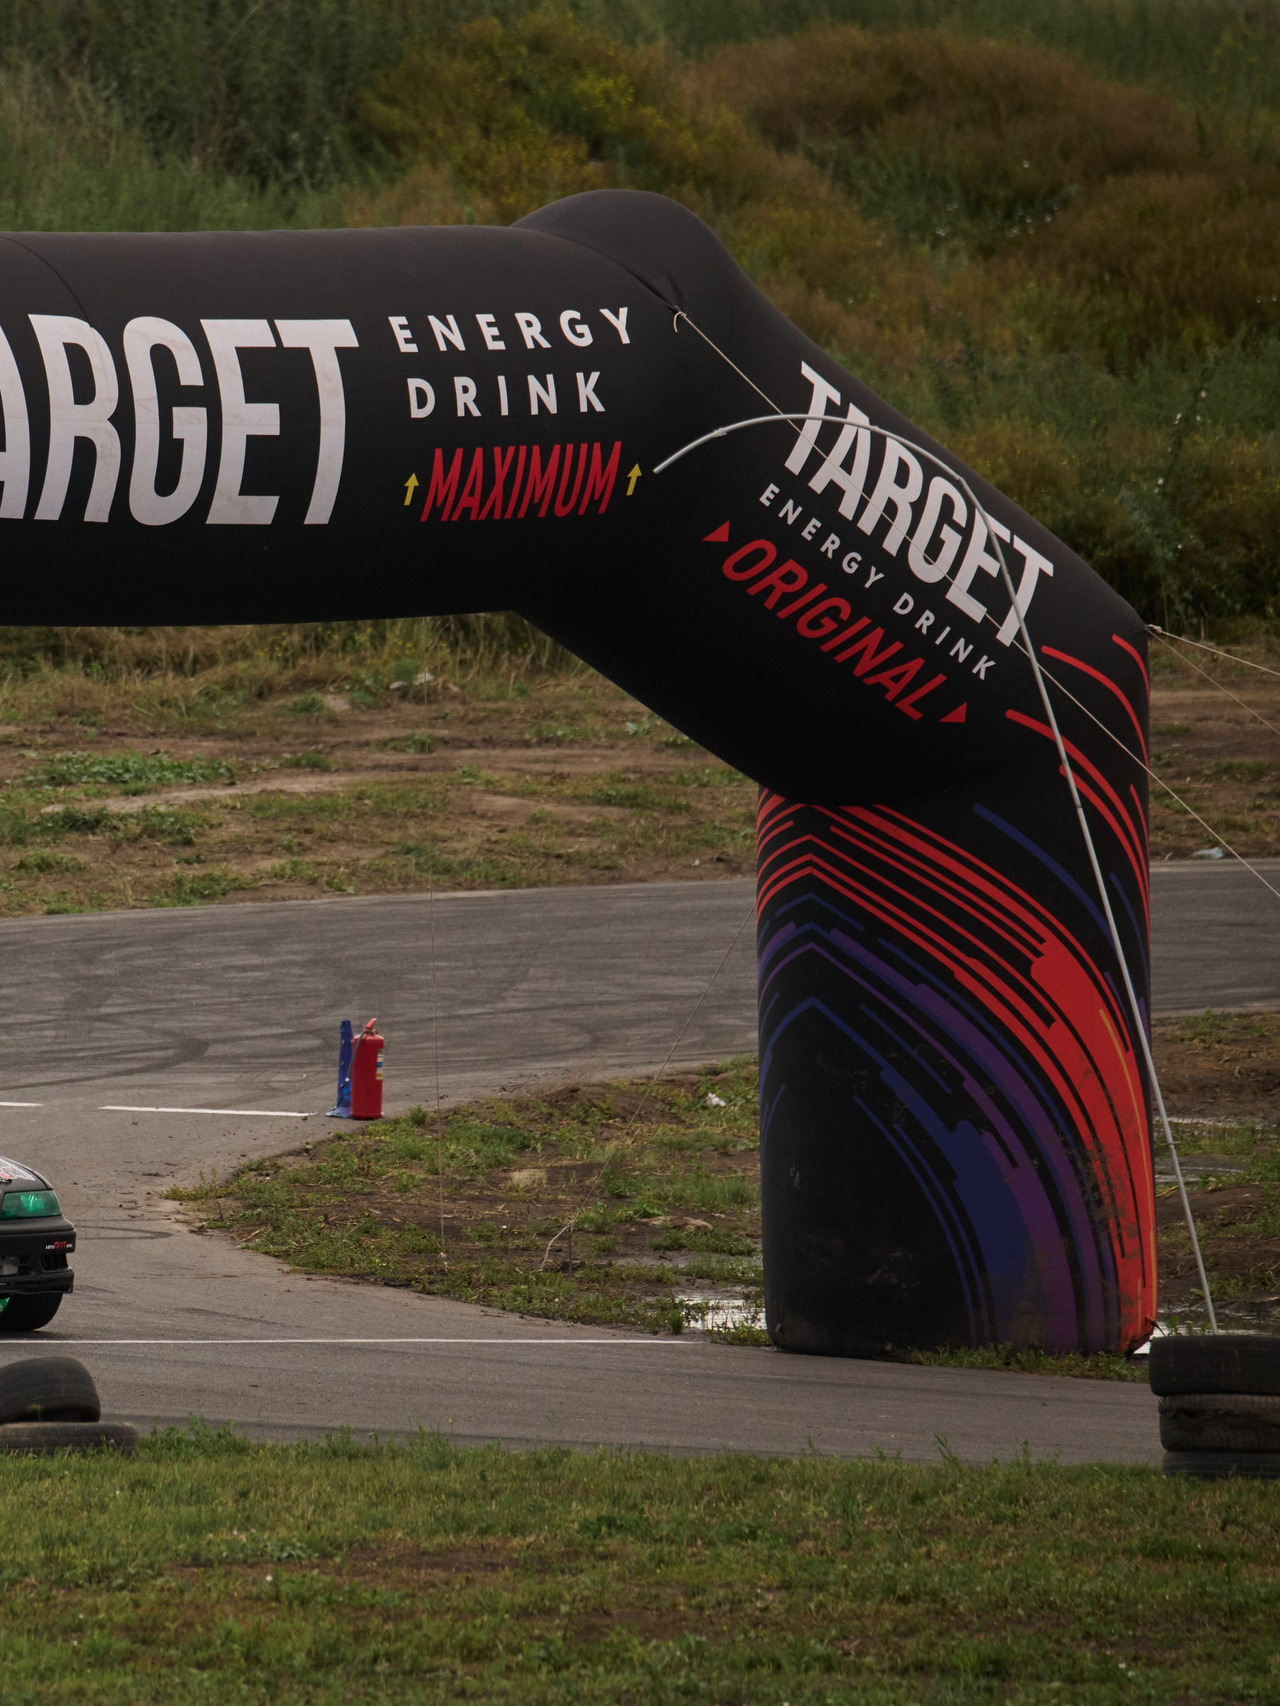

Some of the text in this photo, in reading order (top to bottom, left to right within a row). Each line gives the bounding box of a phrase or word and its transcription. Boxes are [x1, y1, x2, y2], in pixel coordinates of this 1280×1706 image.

[388, 307, 631, 353] ENERGY
[407, 371, 606, 419] DRINK
[419, 440, 622, 522] MAXIMUM
[784, 360, 1054, 647] TARGET
[722, 539, 947, 721] ORIGINAL
[759, 483, 996, 680] ENERGY DRINK
